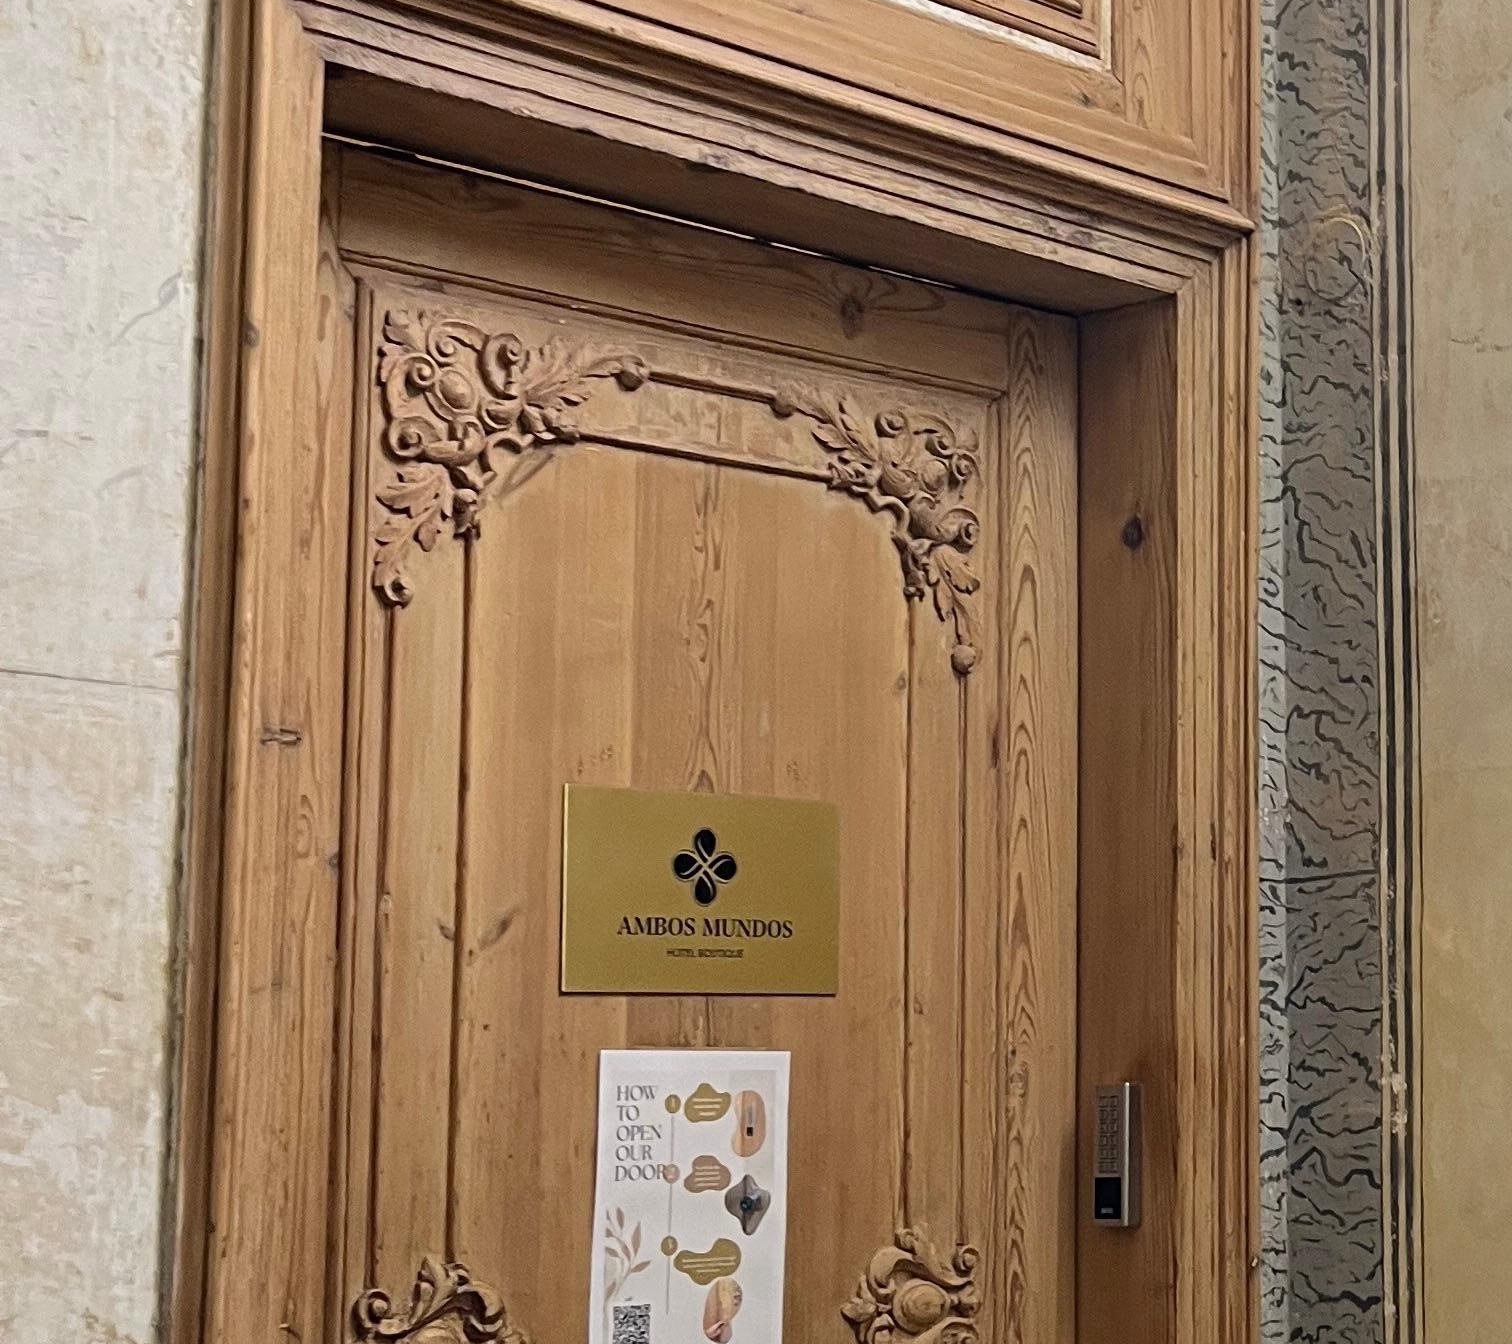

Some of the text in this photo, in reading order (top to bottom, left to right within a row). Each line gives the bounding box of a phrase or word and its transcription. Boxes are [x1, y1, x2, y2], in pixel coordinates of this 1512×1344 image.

[617, 916, 793, 939] AMBOS MUNDOS
[617, 1085, 658, 1101] HOW
[616, 1105, 640, 1121] TO
[616, 1124, 662, 1141] OPEN
[615, 1144, 652, 1161] OUR
